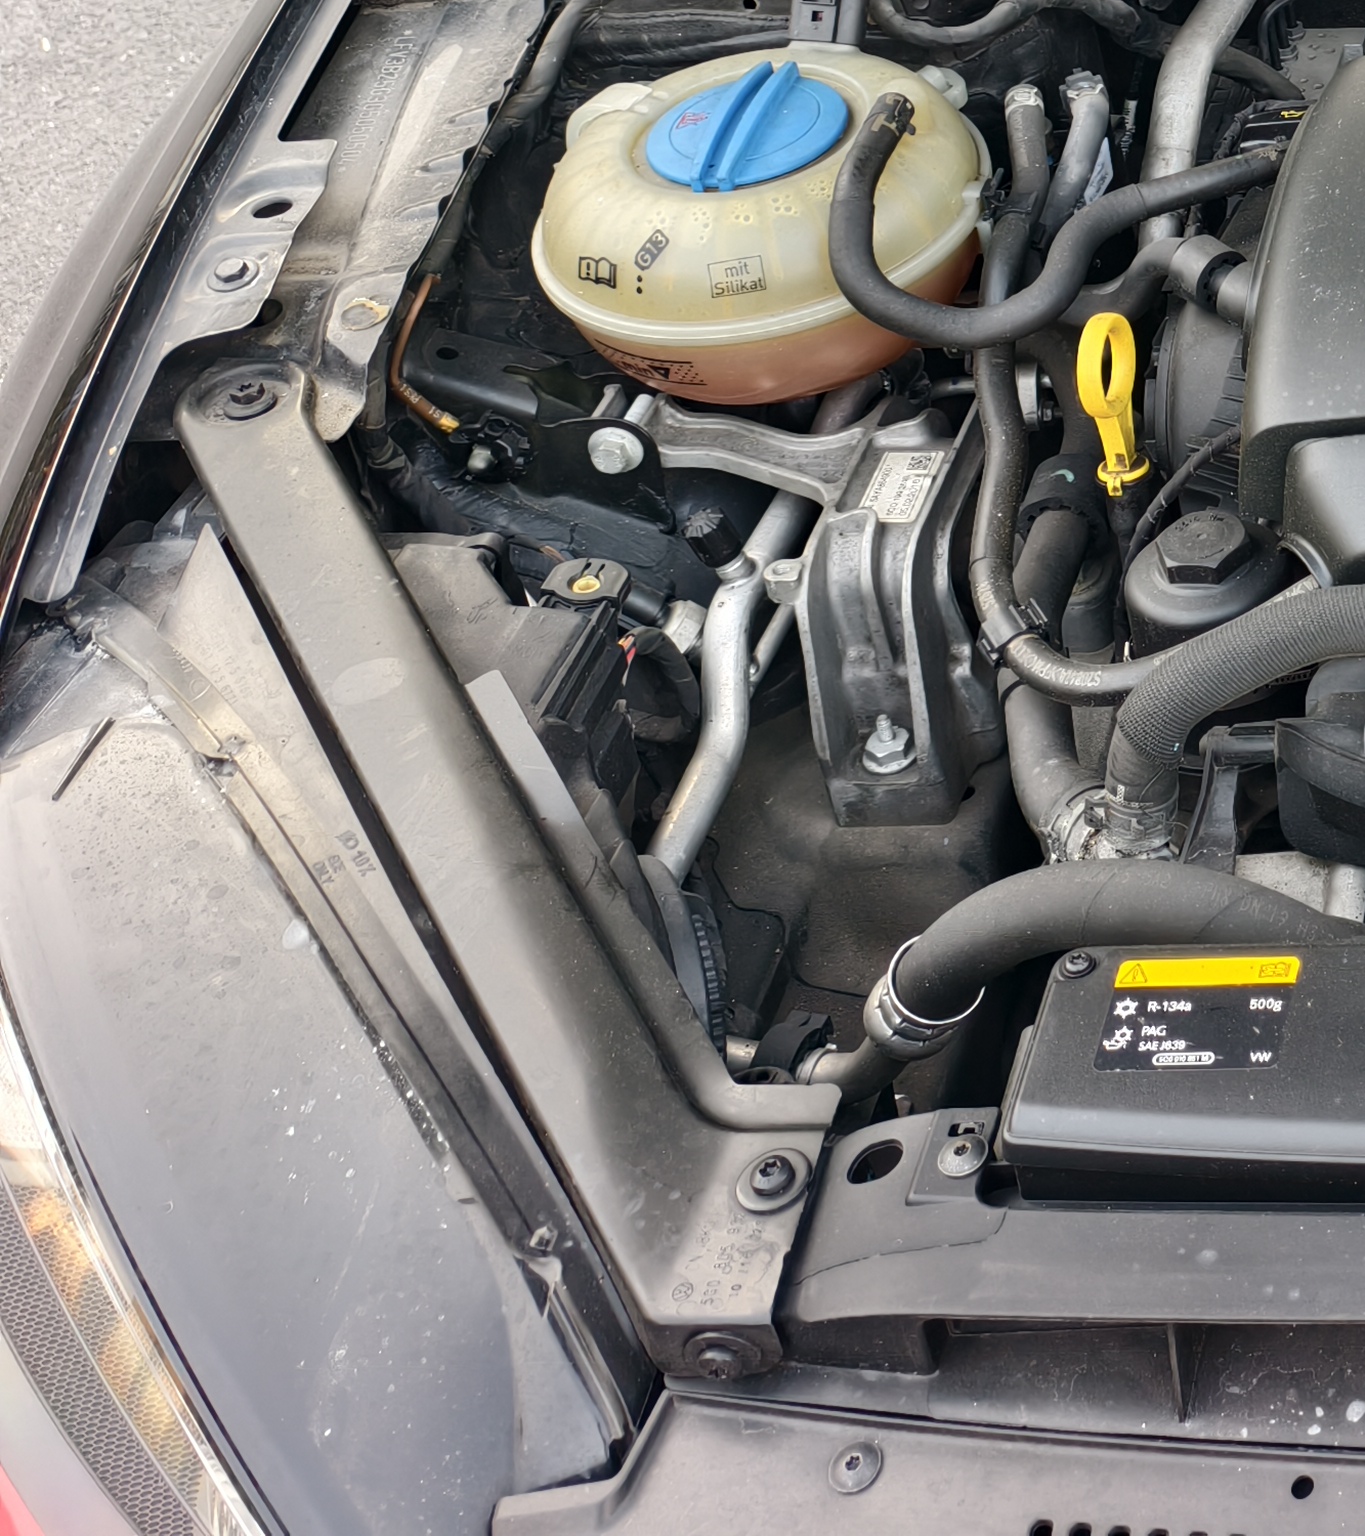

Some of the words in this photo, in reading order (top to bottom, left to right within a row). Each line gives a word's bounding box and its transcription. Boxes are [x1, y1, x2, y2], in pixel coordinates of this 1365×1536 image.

[637, 232, 667, 267] G13
[724, 261, 751, 278] mit
[714, 277, 764, 296] Silikat
[1147, 998, 1193, 1013] R-134a
[1249, 998, 1284, 1013] 500g
[1141, 1025, 1168, 1037] PAG
[1138, 1041, 1160, 1051] SAE
[1249, 1052, 1273, 1063] VW
